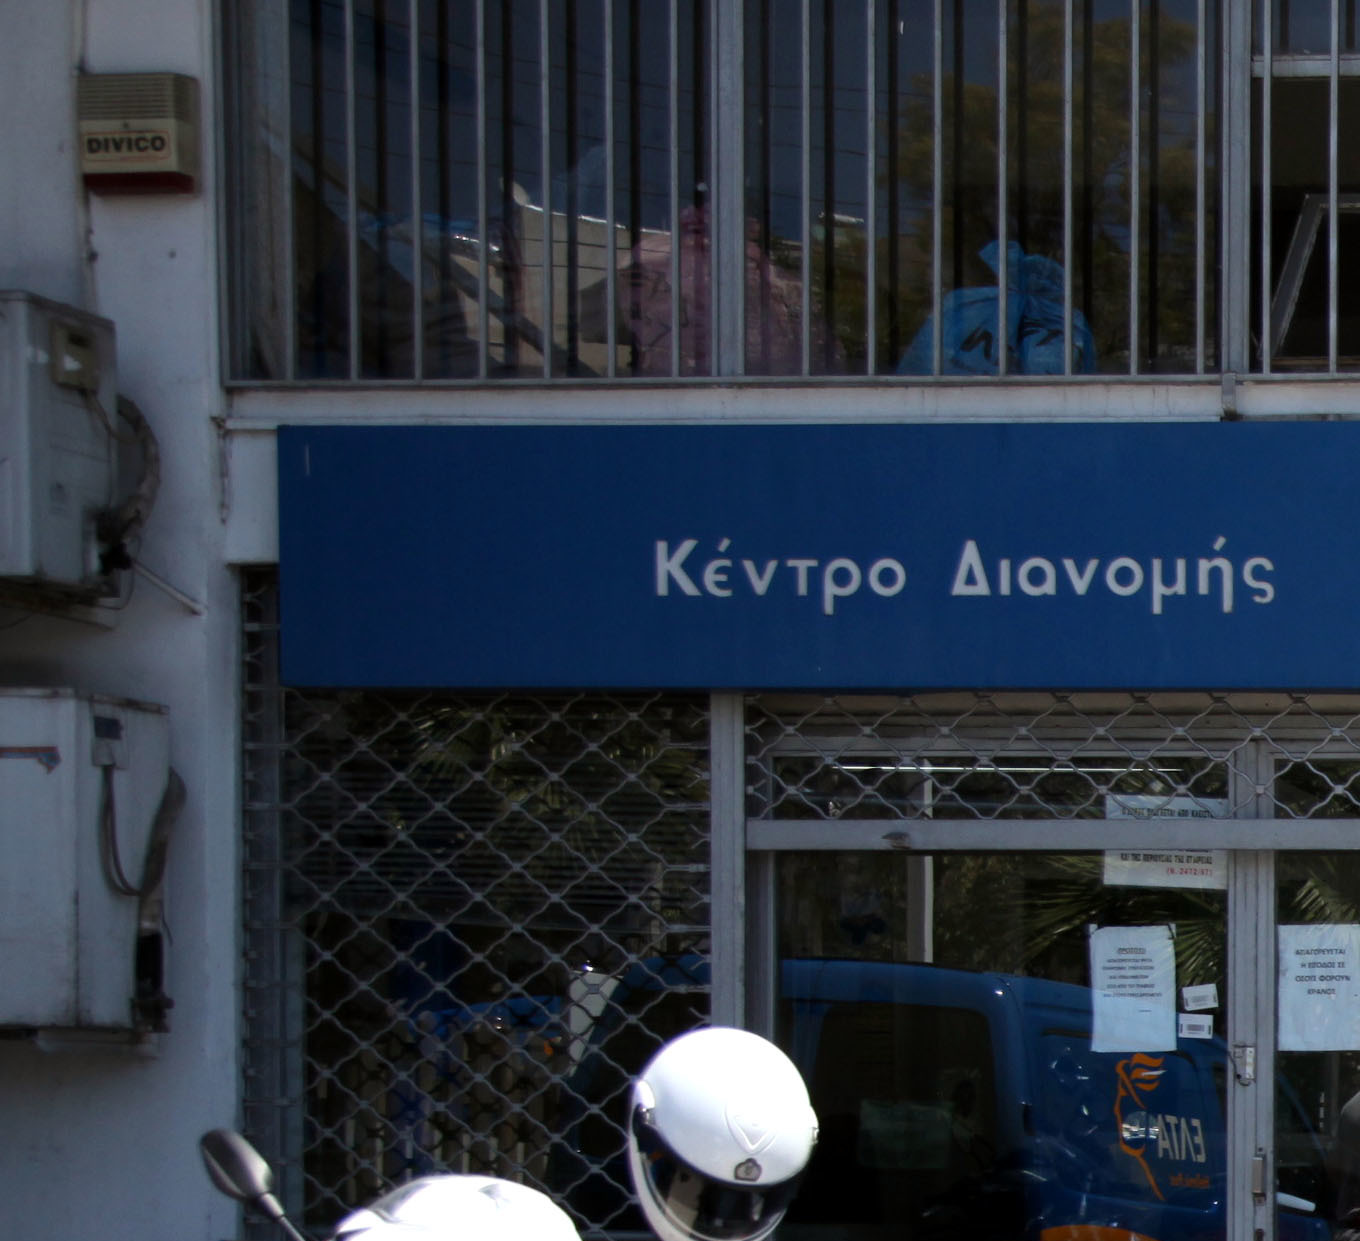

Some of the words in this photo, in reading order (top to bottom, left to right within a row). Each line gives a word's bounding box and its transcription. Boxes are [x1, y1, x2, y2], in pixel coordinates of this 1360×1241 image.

[87, 135, 166, 154] DIVICO
[655, 537, 906, 615] Κέντρο
[950, 536, 1275, 613] Διανομής
